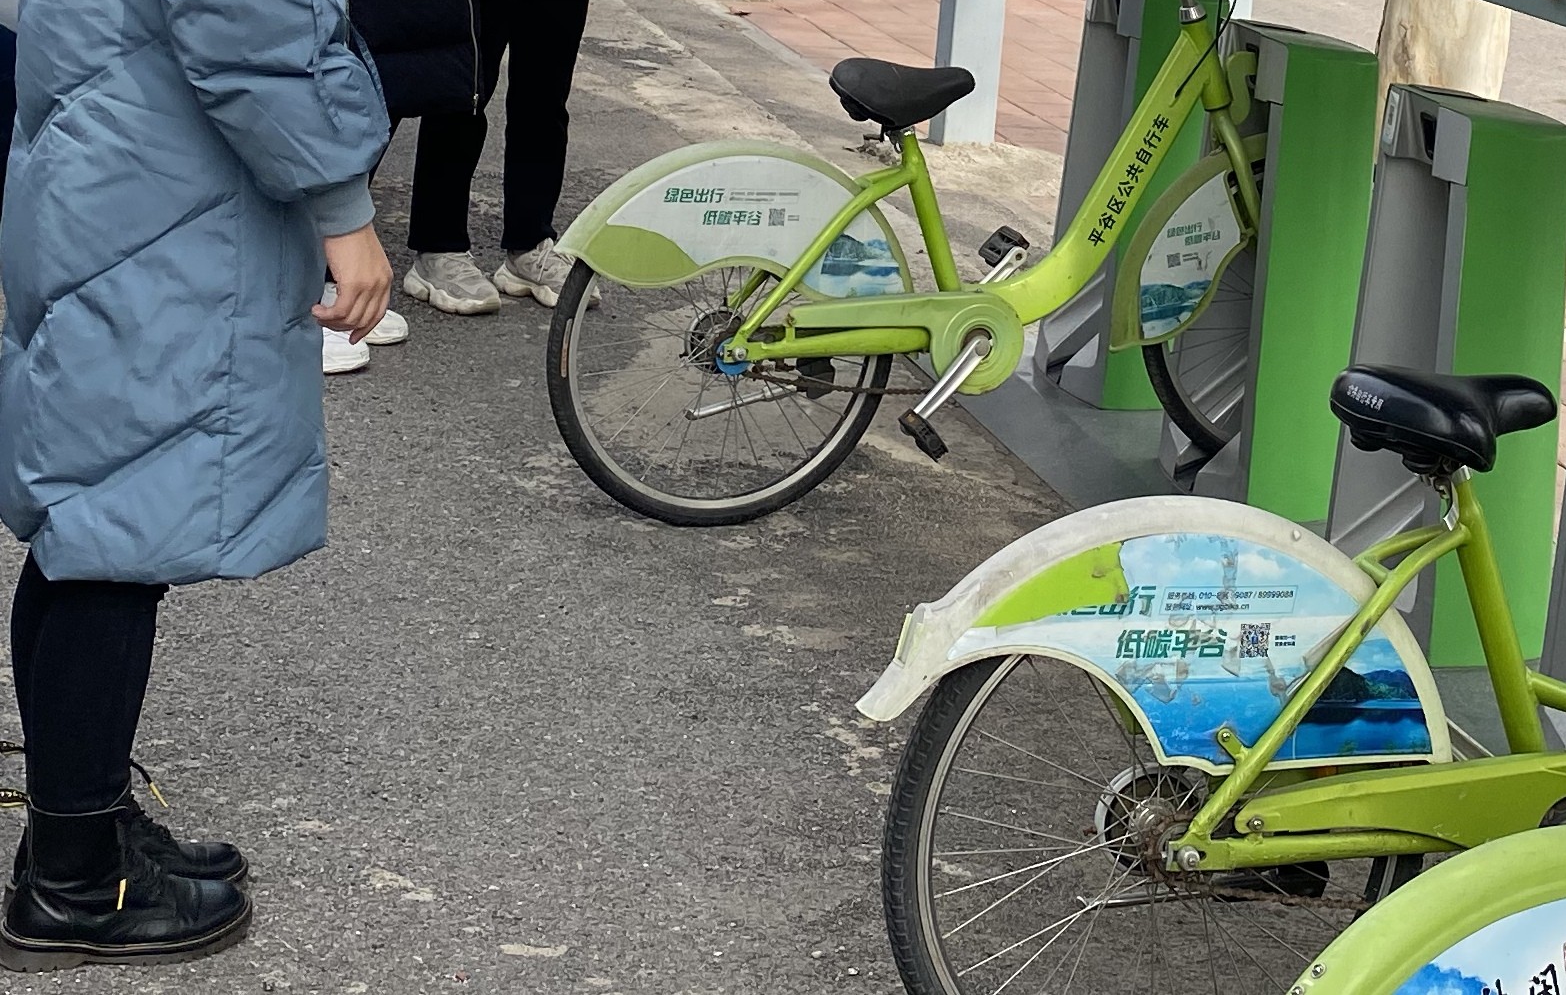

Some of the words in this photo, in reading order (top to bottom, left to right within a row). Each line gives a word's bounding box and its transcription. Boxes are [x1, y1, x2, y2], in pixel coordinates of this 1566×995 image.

[1088, 114, 1170, 247] 平谷区公共自行车
[664, 188, 725, 204] 绿色出行
[702, 209, 762, 226] 低碳平谷
[1115, 629, 1228, 659] 低碳平谷
